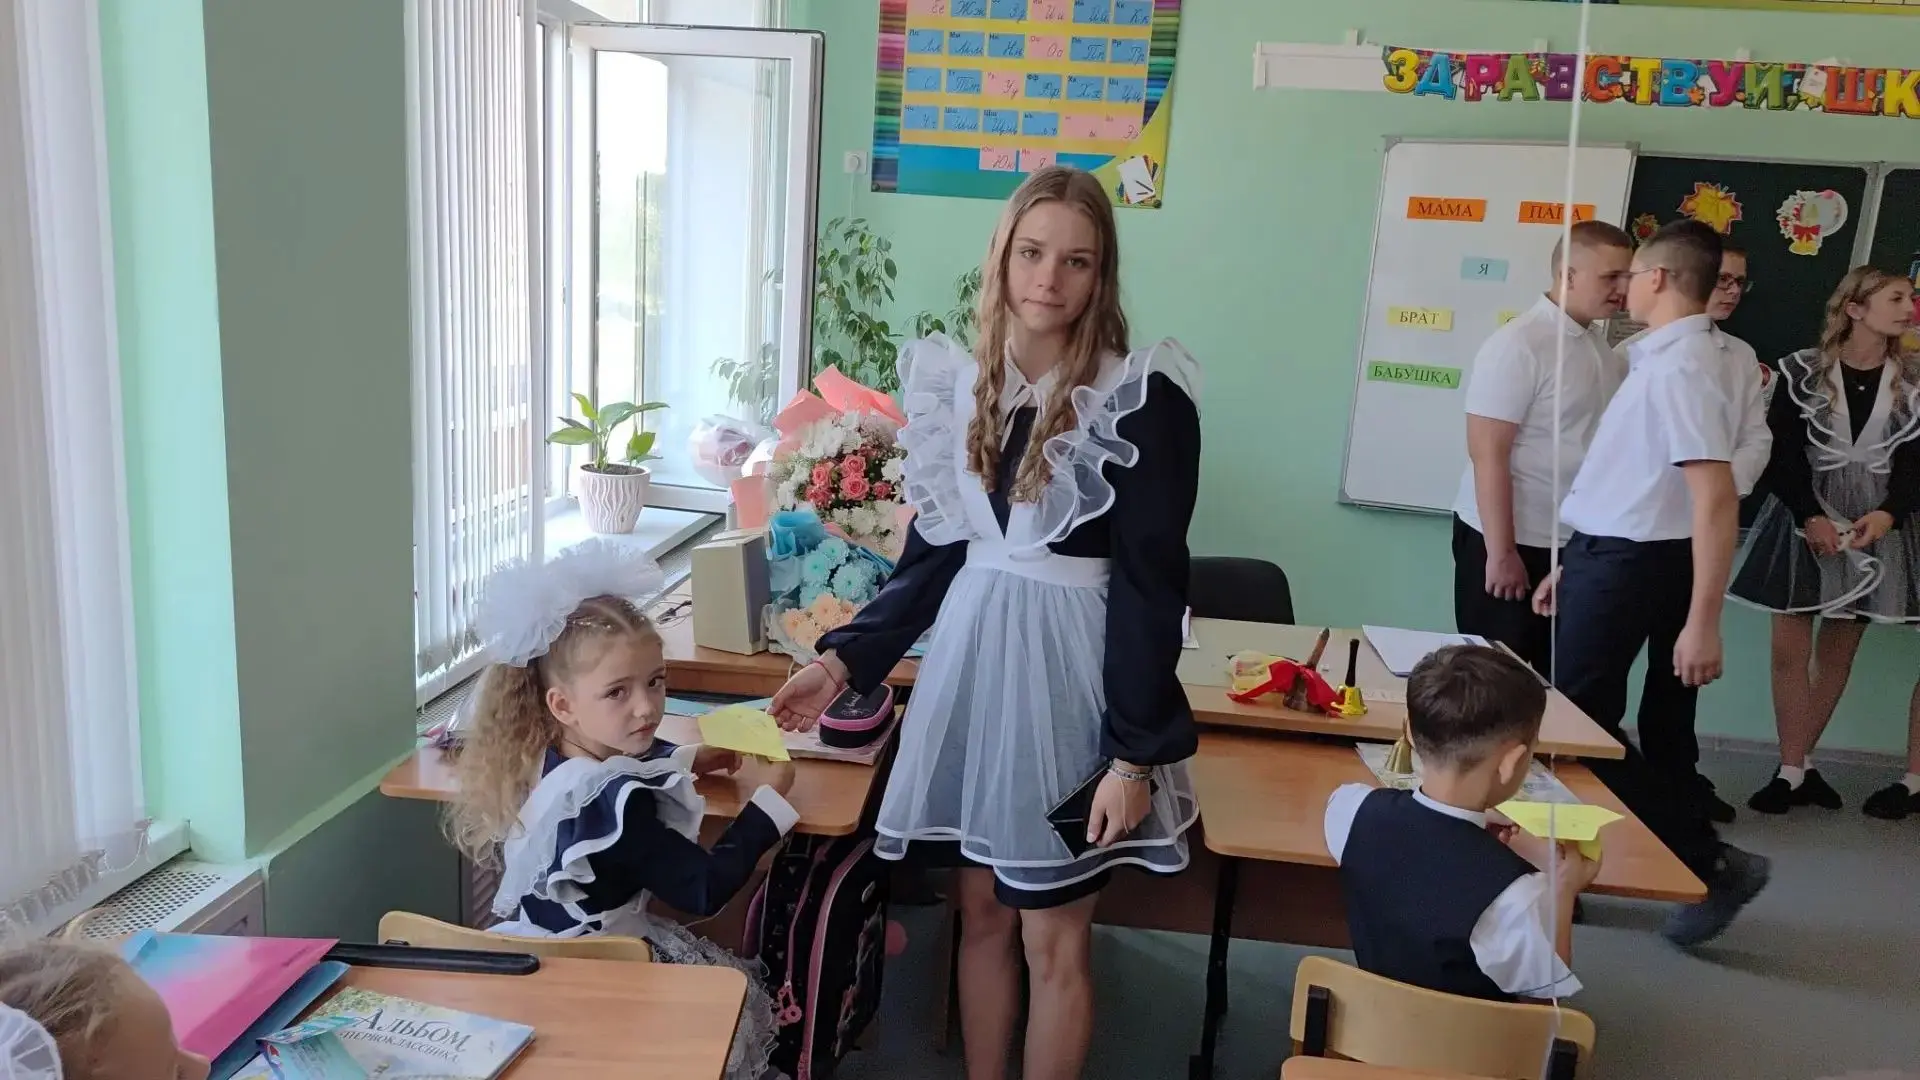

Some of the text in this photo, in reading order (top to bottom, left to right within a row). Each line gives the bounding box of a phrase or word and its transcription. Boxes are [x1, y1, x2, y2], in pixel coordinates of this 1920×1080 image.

[1417, 200, 1474, 218] МАМА
[1477, 262, 1489, 276] Я
[1399, 310, 1441, 325] БРАТ
[1373, 364, 1452, 385] БАБУШКА
